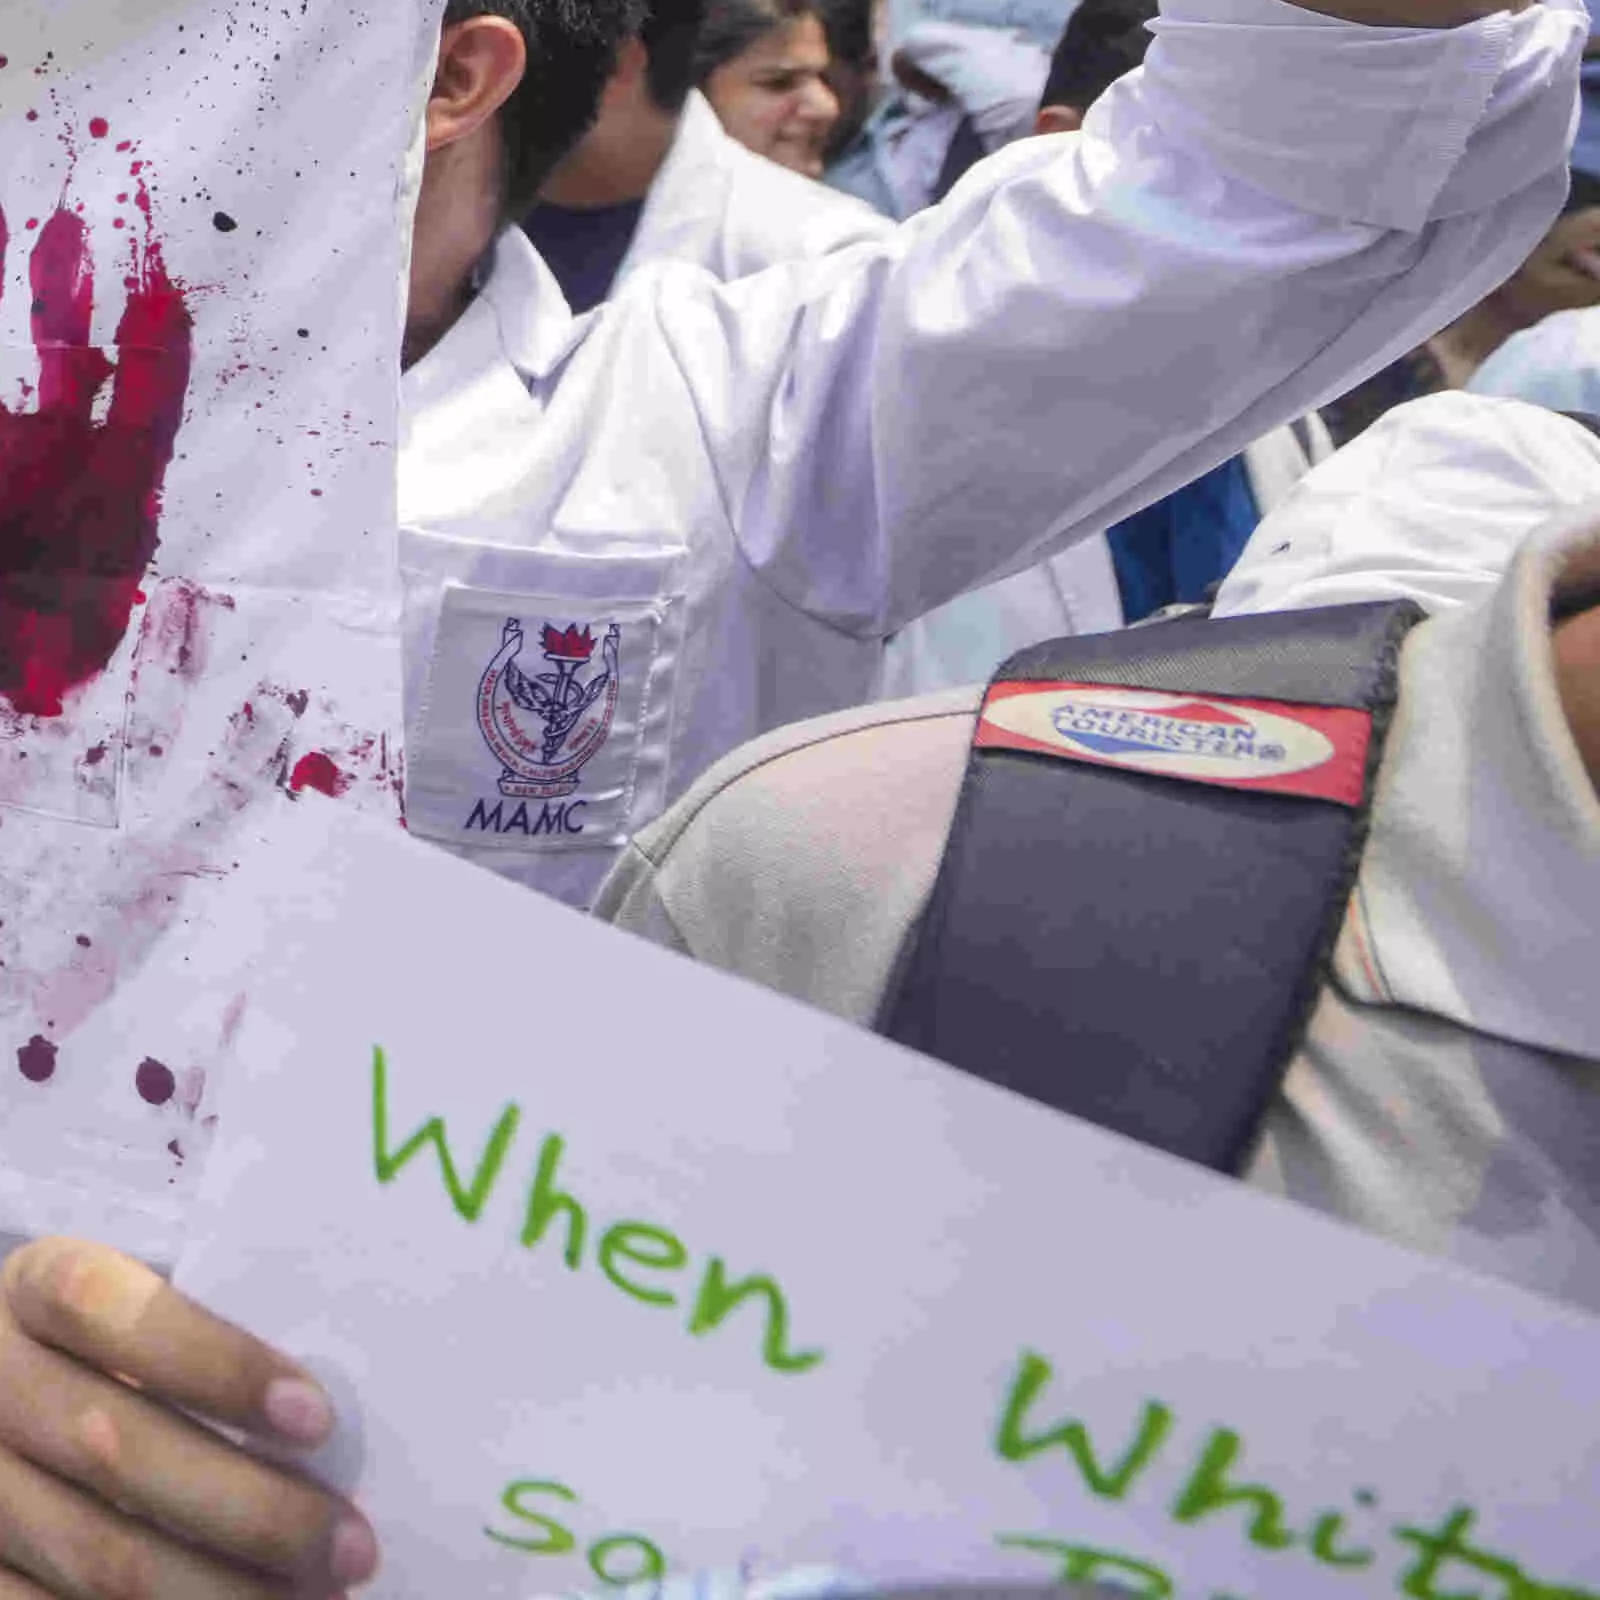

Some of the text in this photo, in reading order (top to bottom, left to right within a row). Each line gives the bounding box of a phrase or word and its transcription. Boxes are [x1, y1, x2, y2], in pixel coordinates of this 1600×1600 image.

[1052, 704, 1257, 740] AMERICAN
[464, 798, 588, 836] MAMC
[372, 1044, 823, 1374] When
